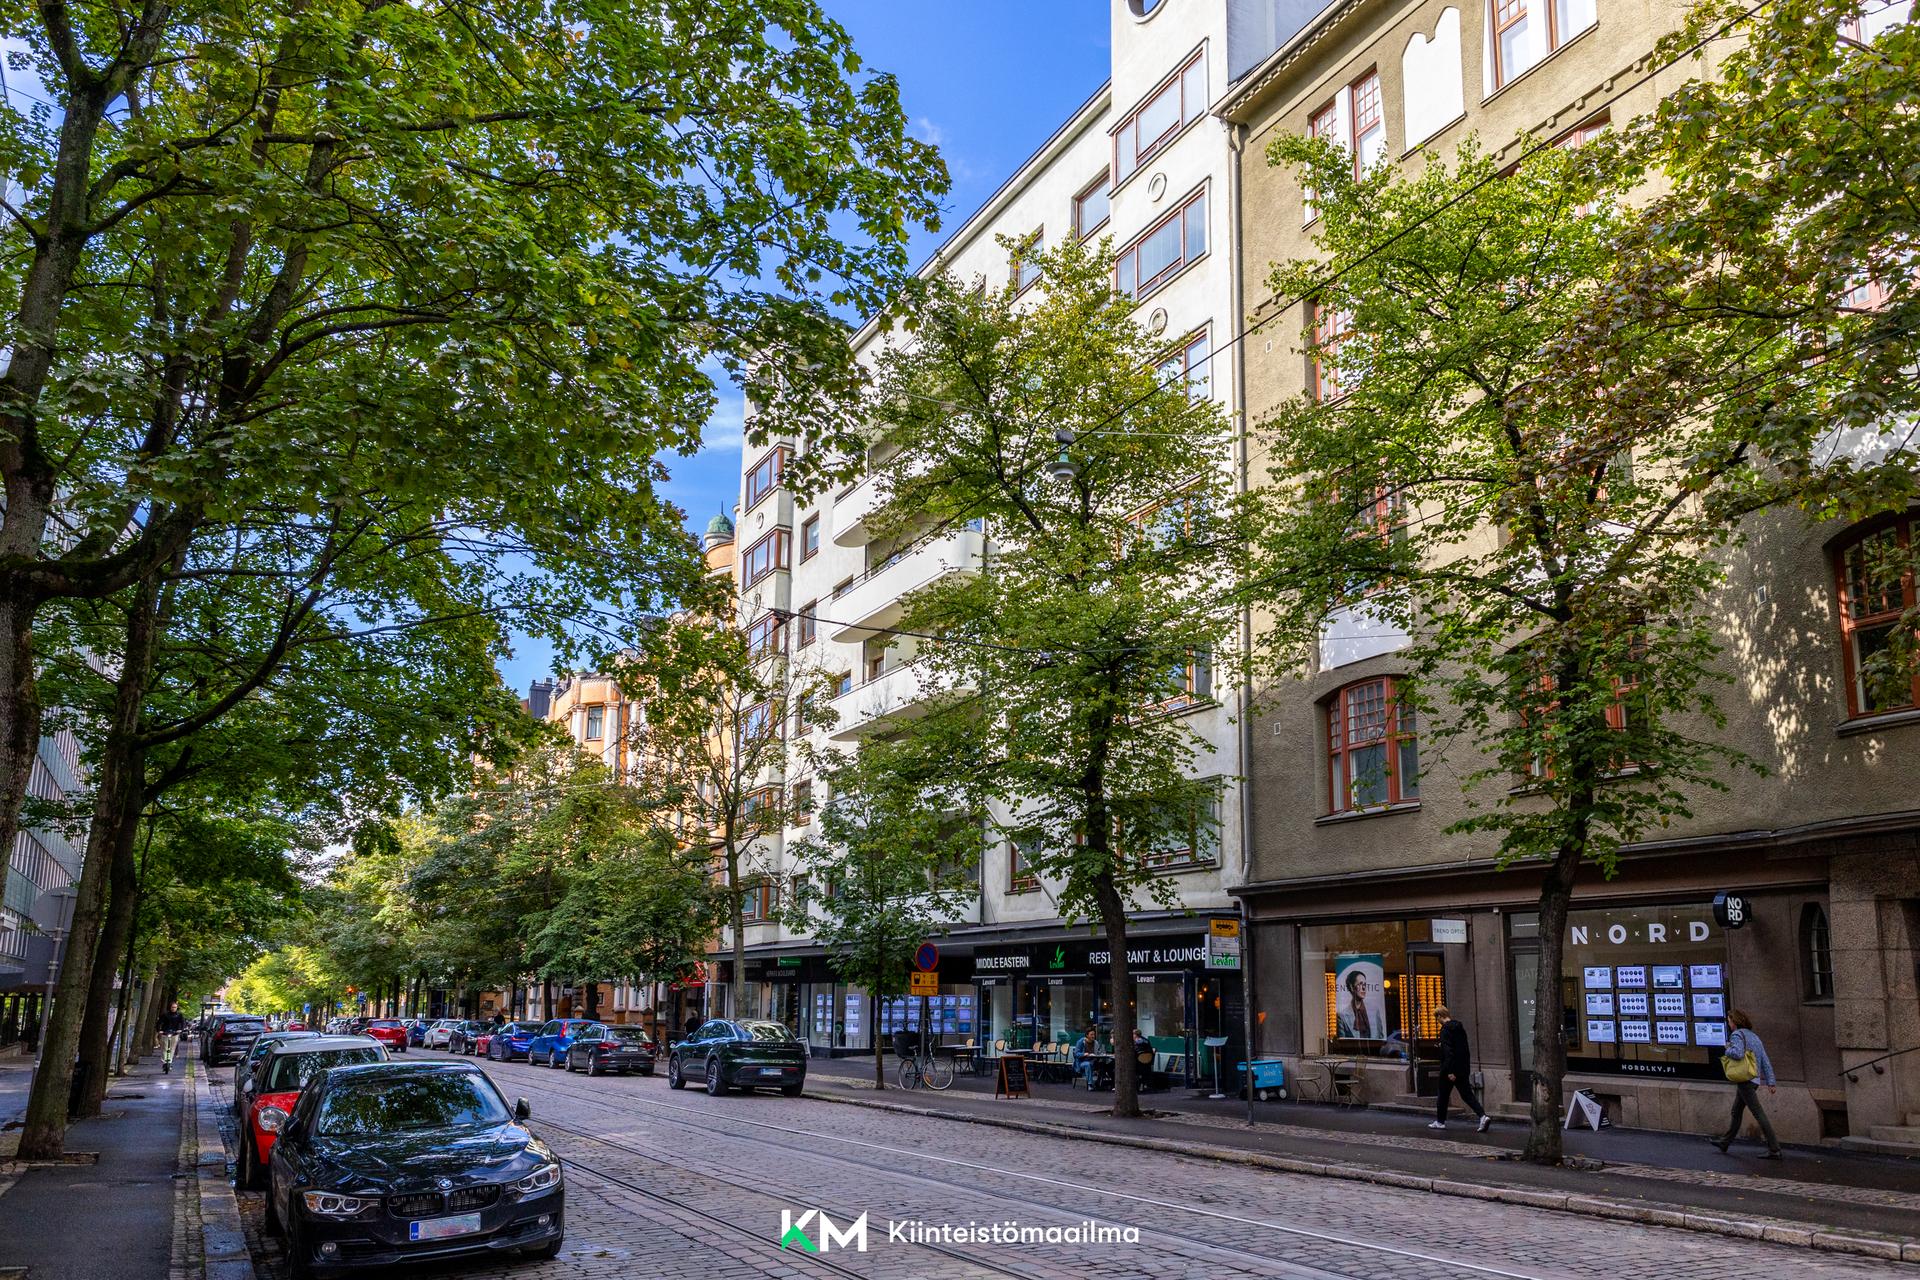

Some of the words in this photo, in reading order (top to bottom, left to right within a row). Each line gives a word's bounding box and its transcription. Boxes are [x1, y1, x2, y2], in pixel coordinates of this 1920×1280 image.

[1726, 897, 1742, 910] NO
[1727, 908, 1743, 921] RD
[1089, 950, 1151, 964] RESTRANT
[1153, 949, 1161, 963] &
[1163, 947, 1206, 962] LOUNGE
[1211, 955, 1236, 967] Levant
[976, 957, 999, 969] MIDDLE
[999, 956, 1030, 968] EASTERN
[982, 978, 996, 986] Levant
[1047, 977, 1063, 985] Levant
[1136, 974, 1156, 983] Levant
